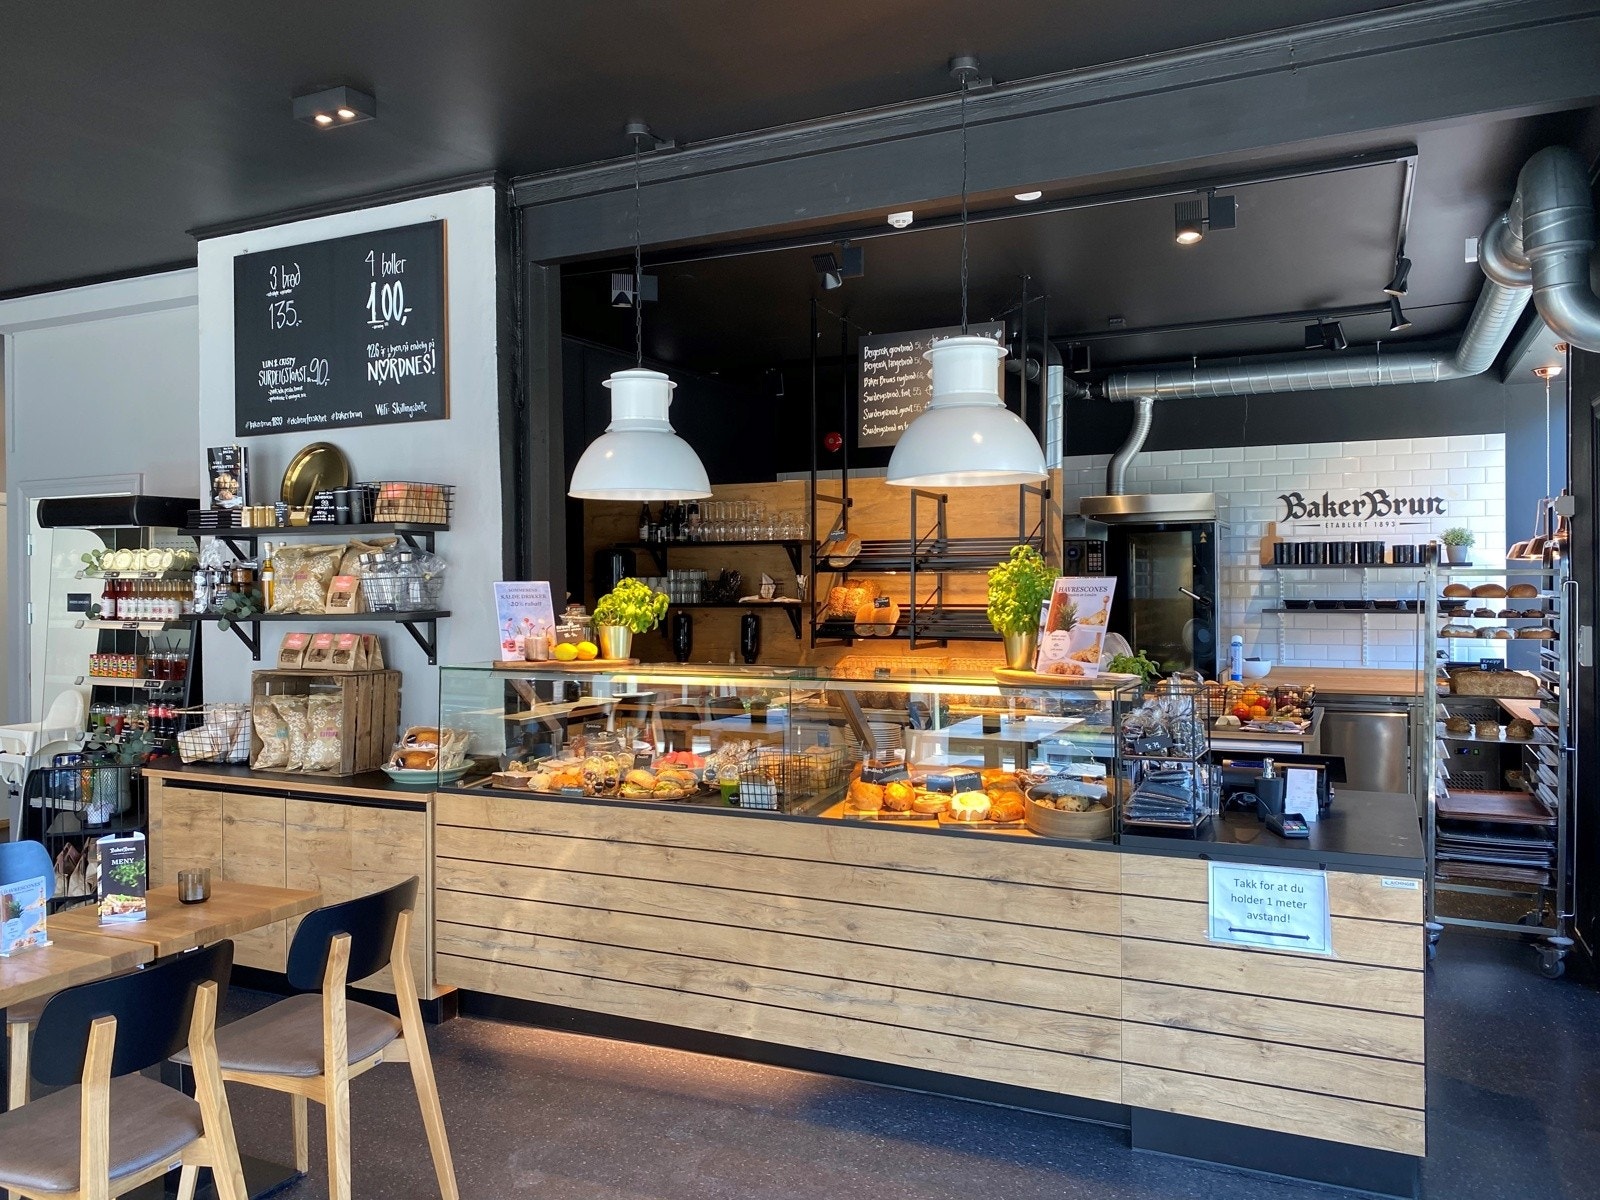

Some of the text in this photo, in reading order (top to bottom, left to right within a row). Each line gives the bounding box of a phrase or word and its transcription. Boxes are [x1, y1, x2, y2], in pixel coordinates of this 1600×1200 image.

[365, 250, 407, 278] 4 boller
[269, 265, 278, 291] 3
[1277, 488, 1447, 524] BakerBrun
[1325, 519, 1396, 530] ETABLERT 1893
[1058, 585, 1109, 593] HAVRESCONES
[111, 857, 135, 866] MENY
[1234, 878, 1305, 894] Takk for at du
[1230, 893, 1308, 910] holder 1 meter
[1246, 911, 1291, 924] avstand!
